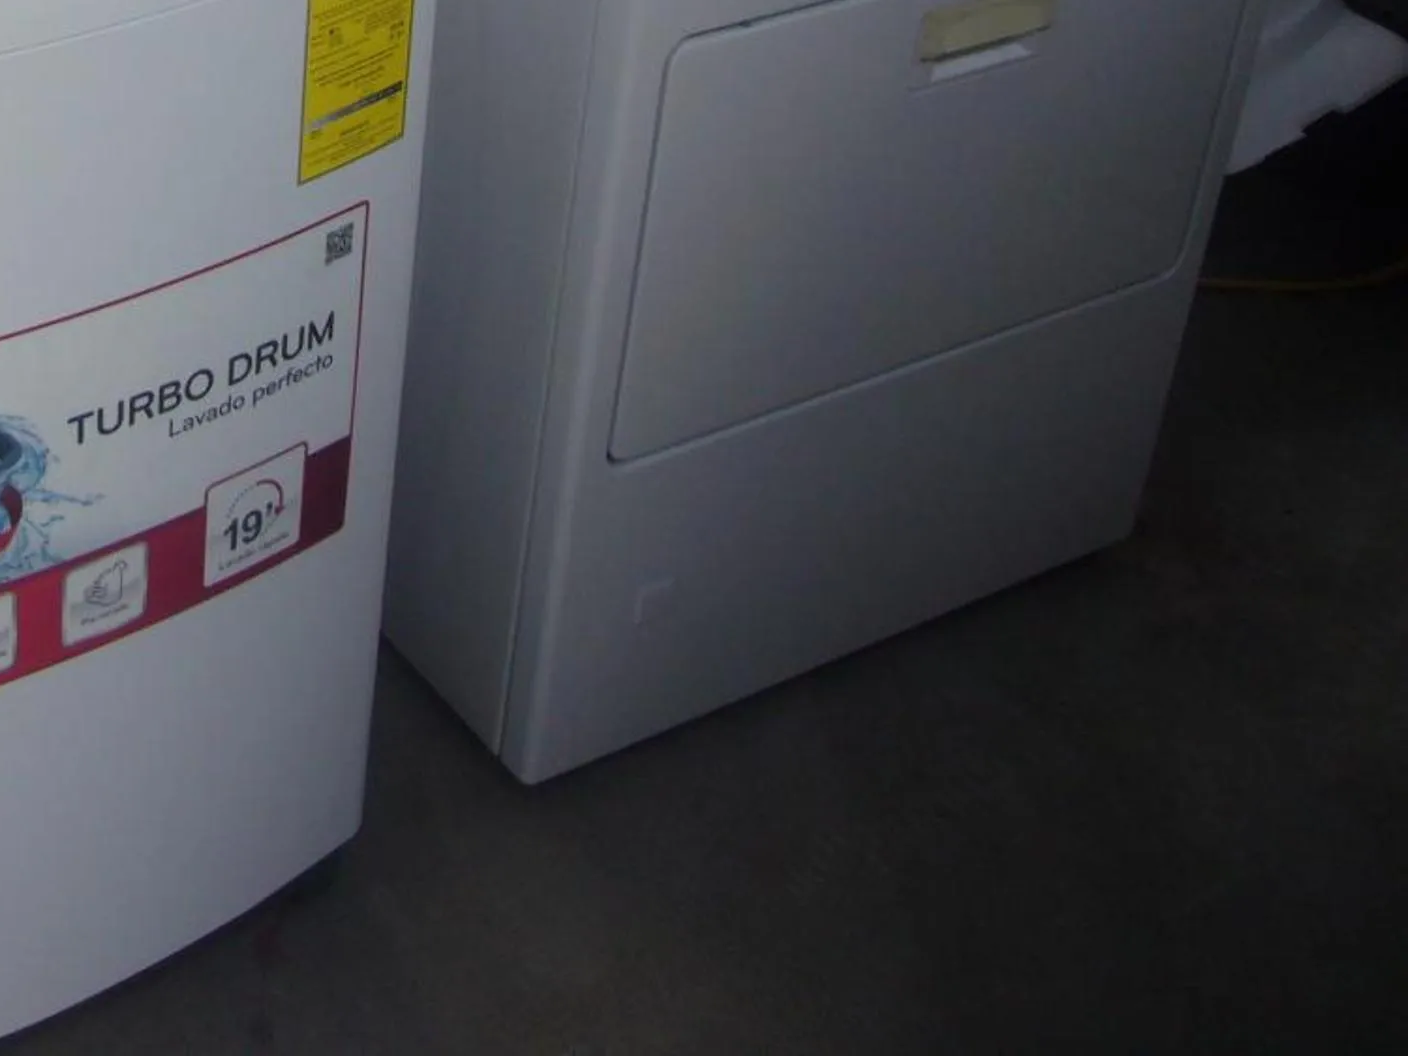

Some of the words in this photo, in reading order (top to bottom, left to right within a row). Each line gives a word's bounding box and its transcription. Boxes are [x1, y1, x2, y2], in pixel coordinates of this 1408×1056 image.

[67, 368, 214, 445] TURBO
[228, 310, 335, 386] DRUM
[168, 395, 246, 438] Lavado
[252, 353, 334, 408] perfecto
